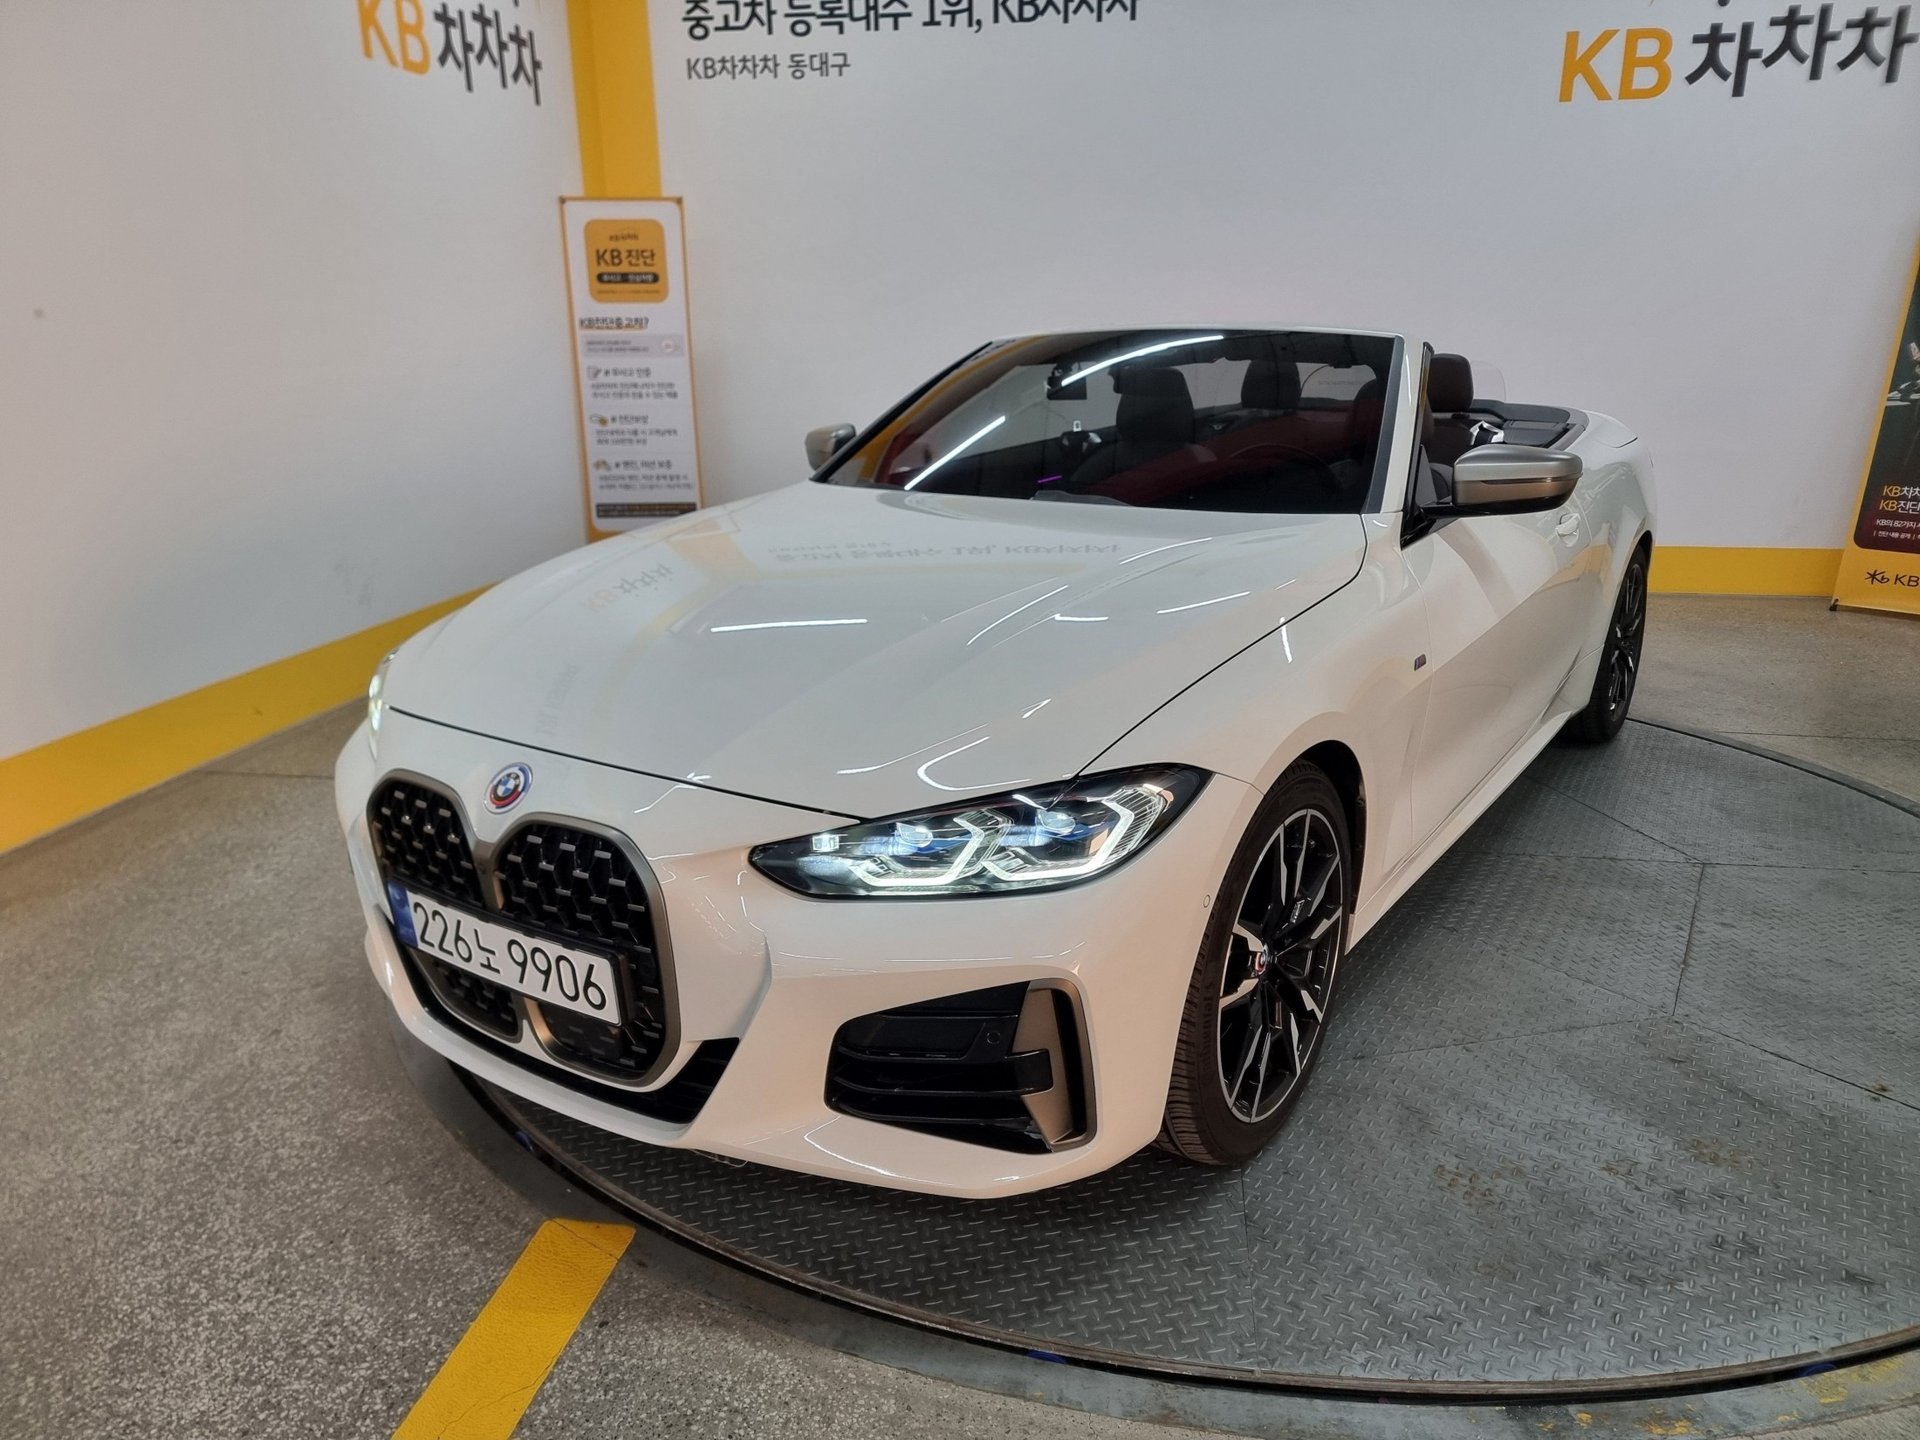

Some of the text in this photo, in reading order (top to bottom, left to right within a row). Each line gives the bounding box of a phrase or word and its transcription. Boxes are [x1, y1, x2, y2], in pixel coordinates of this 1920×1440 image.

[682, 0, 777, 40] 중고차
[784, 0, 913, 37] 등록대수
[922, 0, 983, 33] 1위,
[357, 0, 543, 106] KB 차차차
[686, 52, 851, 80] KB차차차 동대구
[1559, 0, 1920, 103] KB 차차차
[595, 248, 657, 267] KB 진단
[1894, 573, 1920, 587] KB
